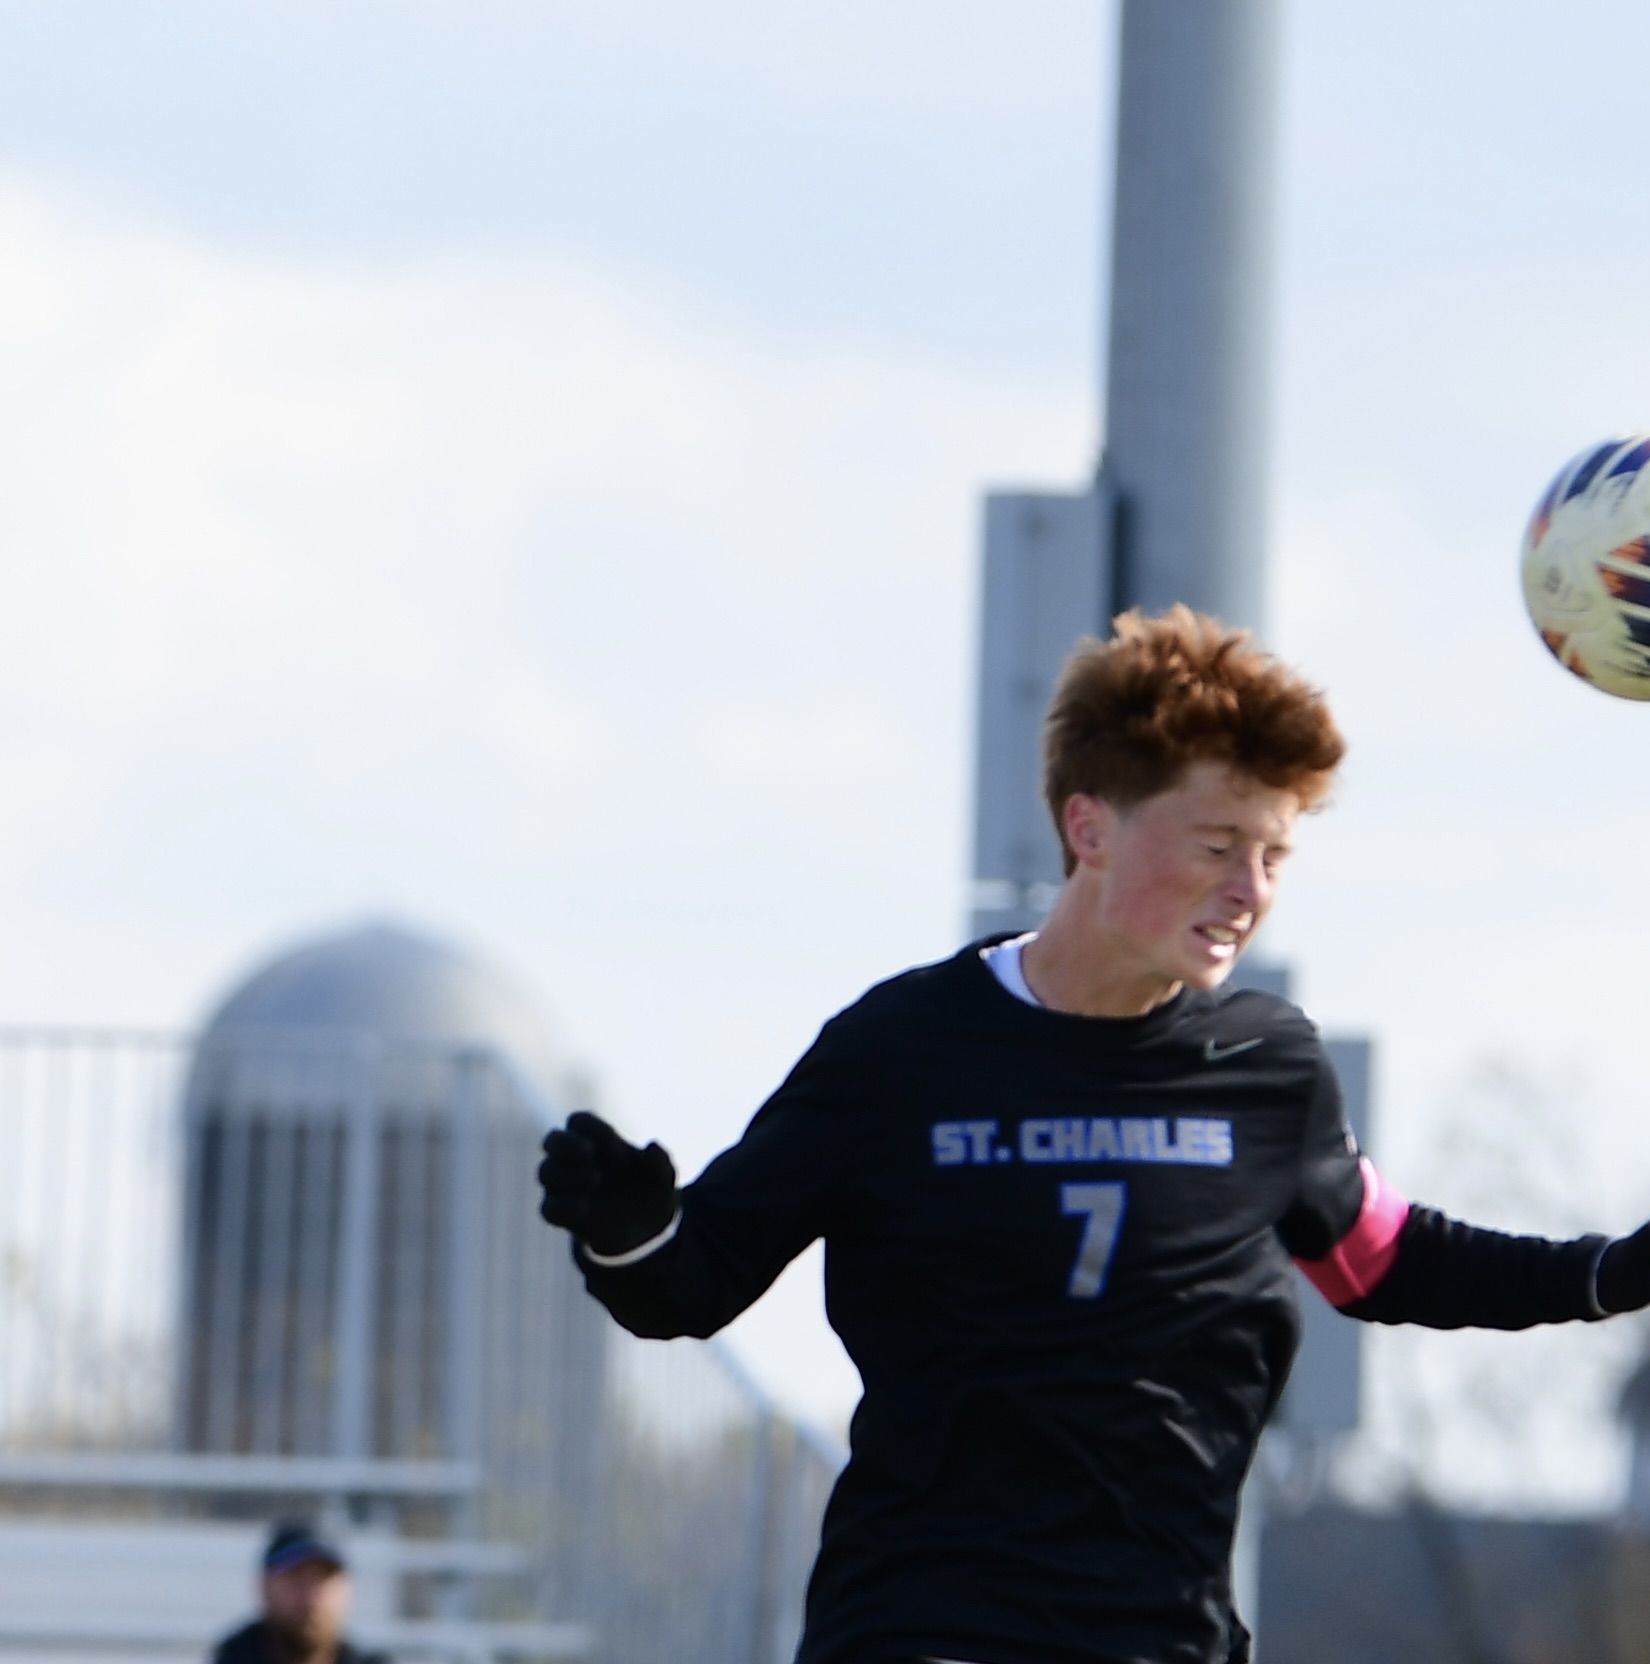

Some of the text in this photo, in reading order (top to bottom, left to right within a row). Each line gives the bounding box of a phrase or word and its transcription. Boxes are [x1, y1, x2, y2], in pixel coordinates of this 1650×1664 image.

[931, 1116, 1234, 1167] ST. CHARLES
[1059, 1181, 1128, 1299] 7
